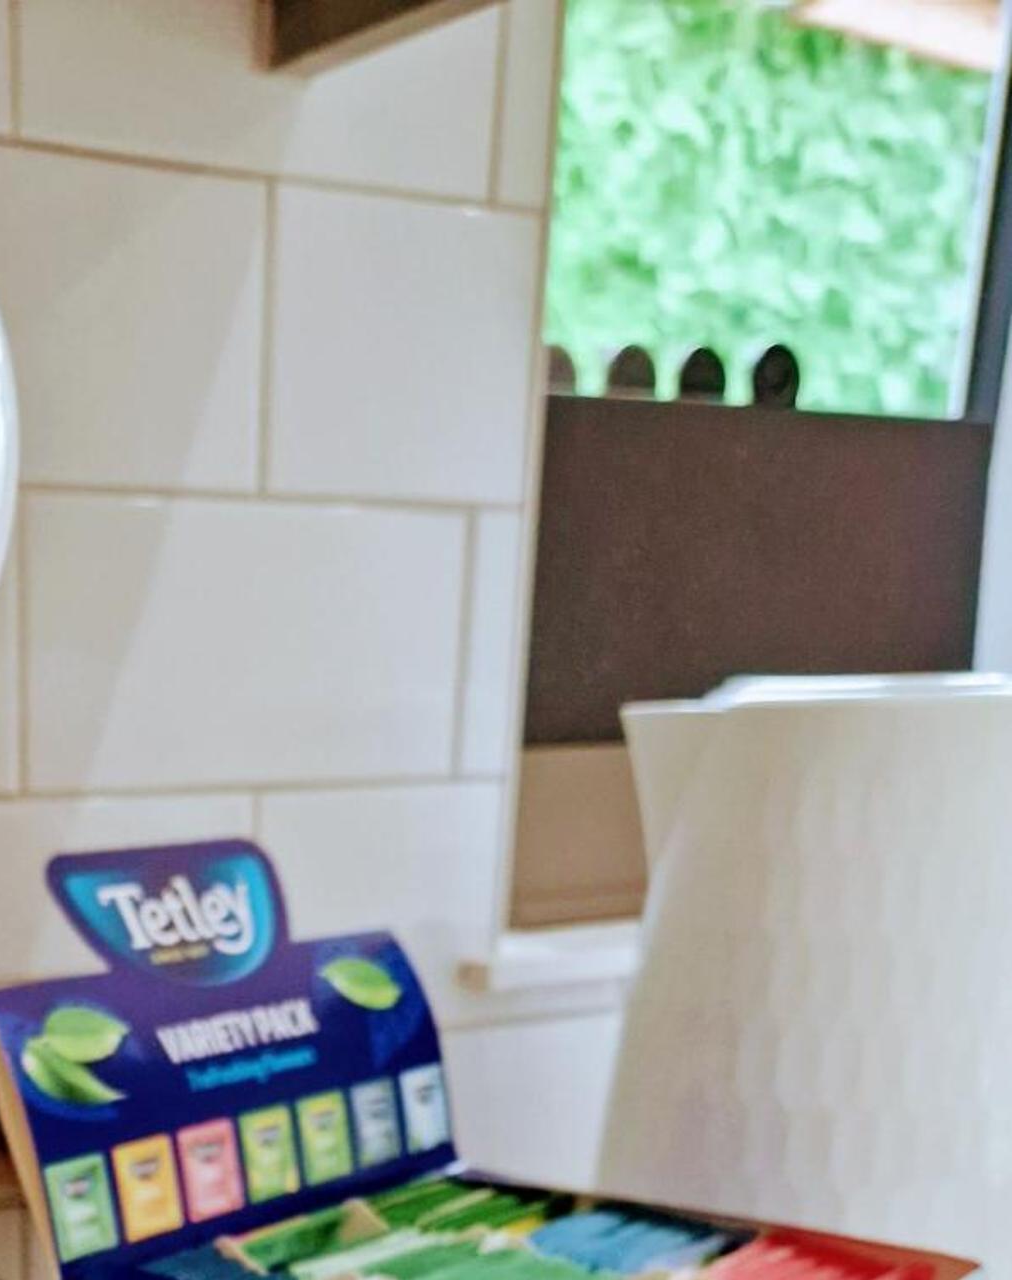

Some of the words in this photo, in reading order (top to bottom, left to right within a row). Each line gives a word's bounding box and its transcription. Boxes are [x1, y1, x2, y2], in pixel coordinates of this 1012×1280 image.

[97, 875, 255, 955] Tetley
[156, 1010, 256, 1064] VARIETY
[251, 998, 319, 1045] PACK
